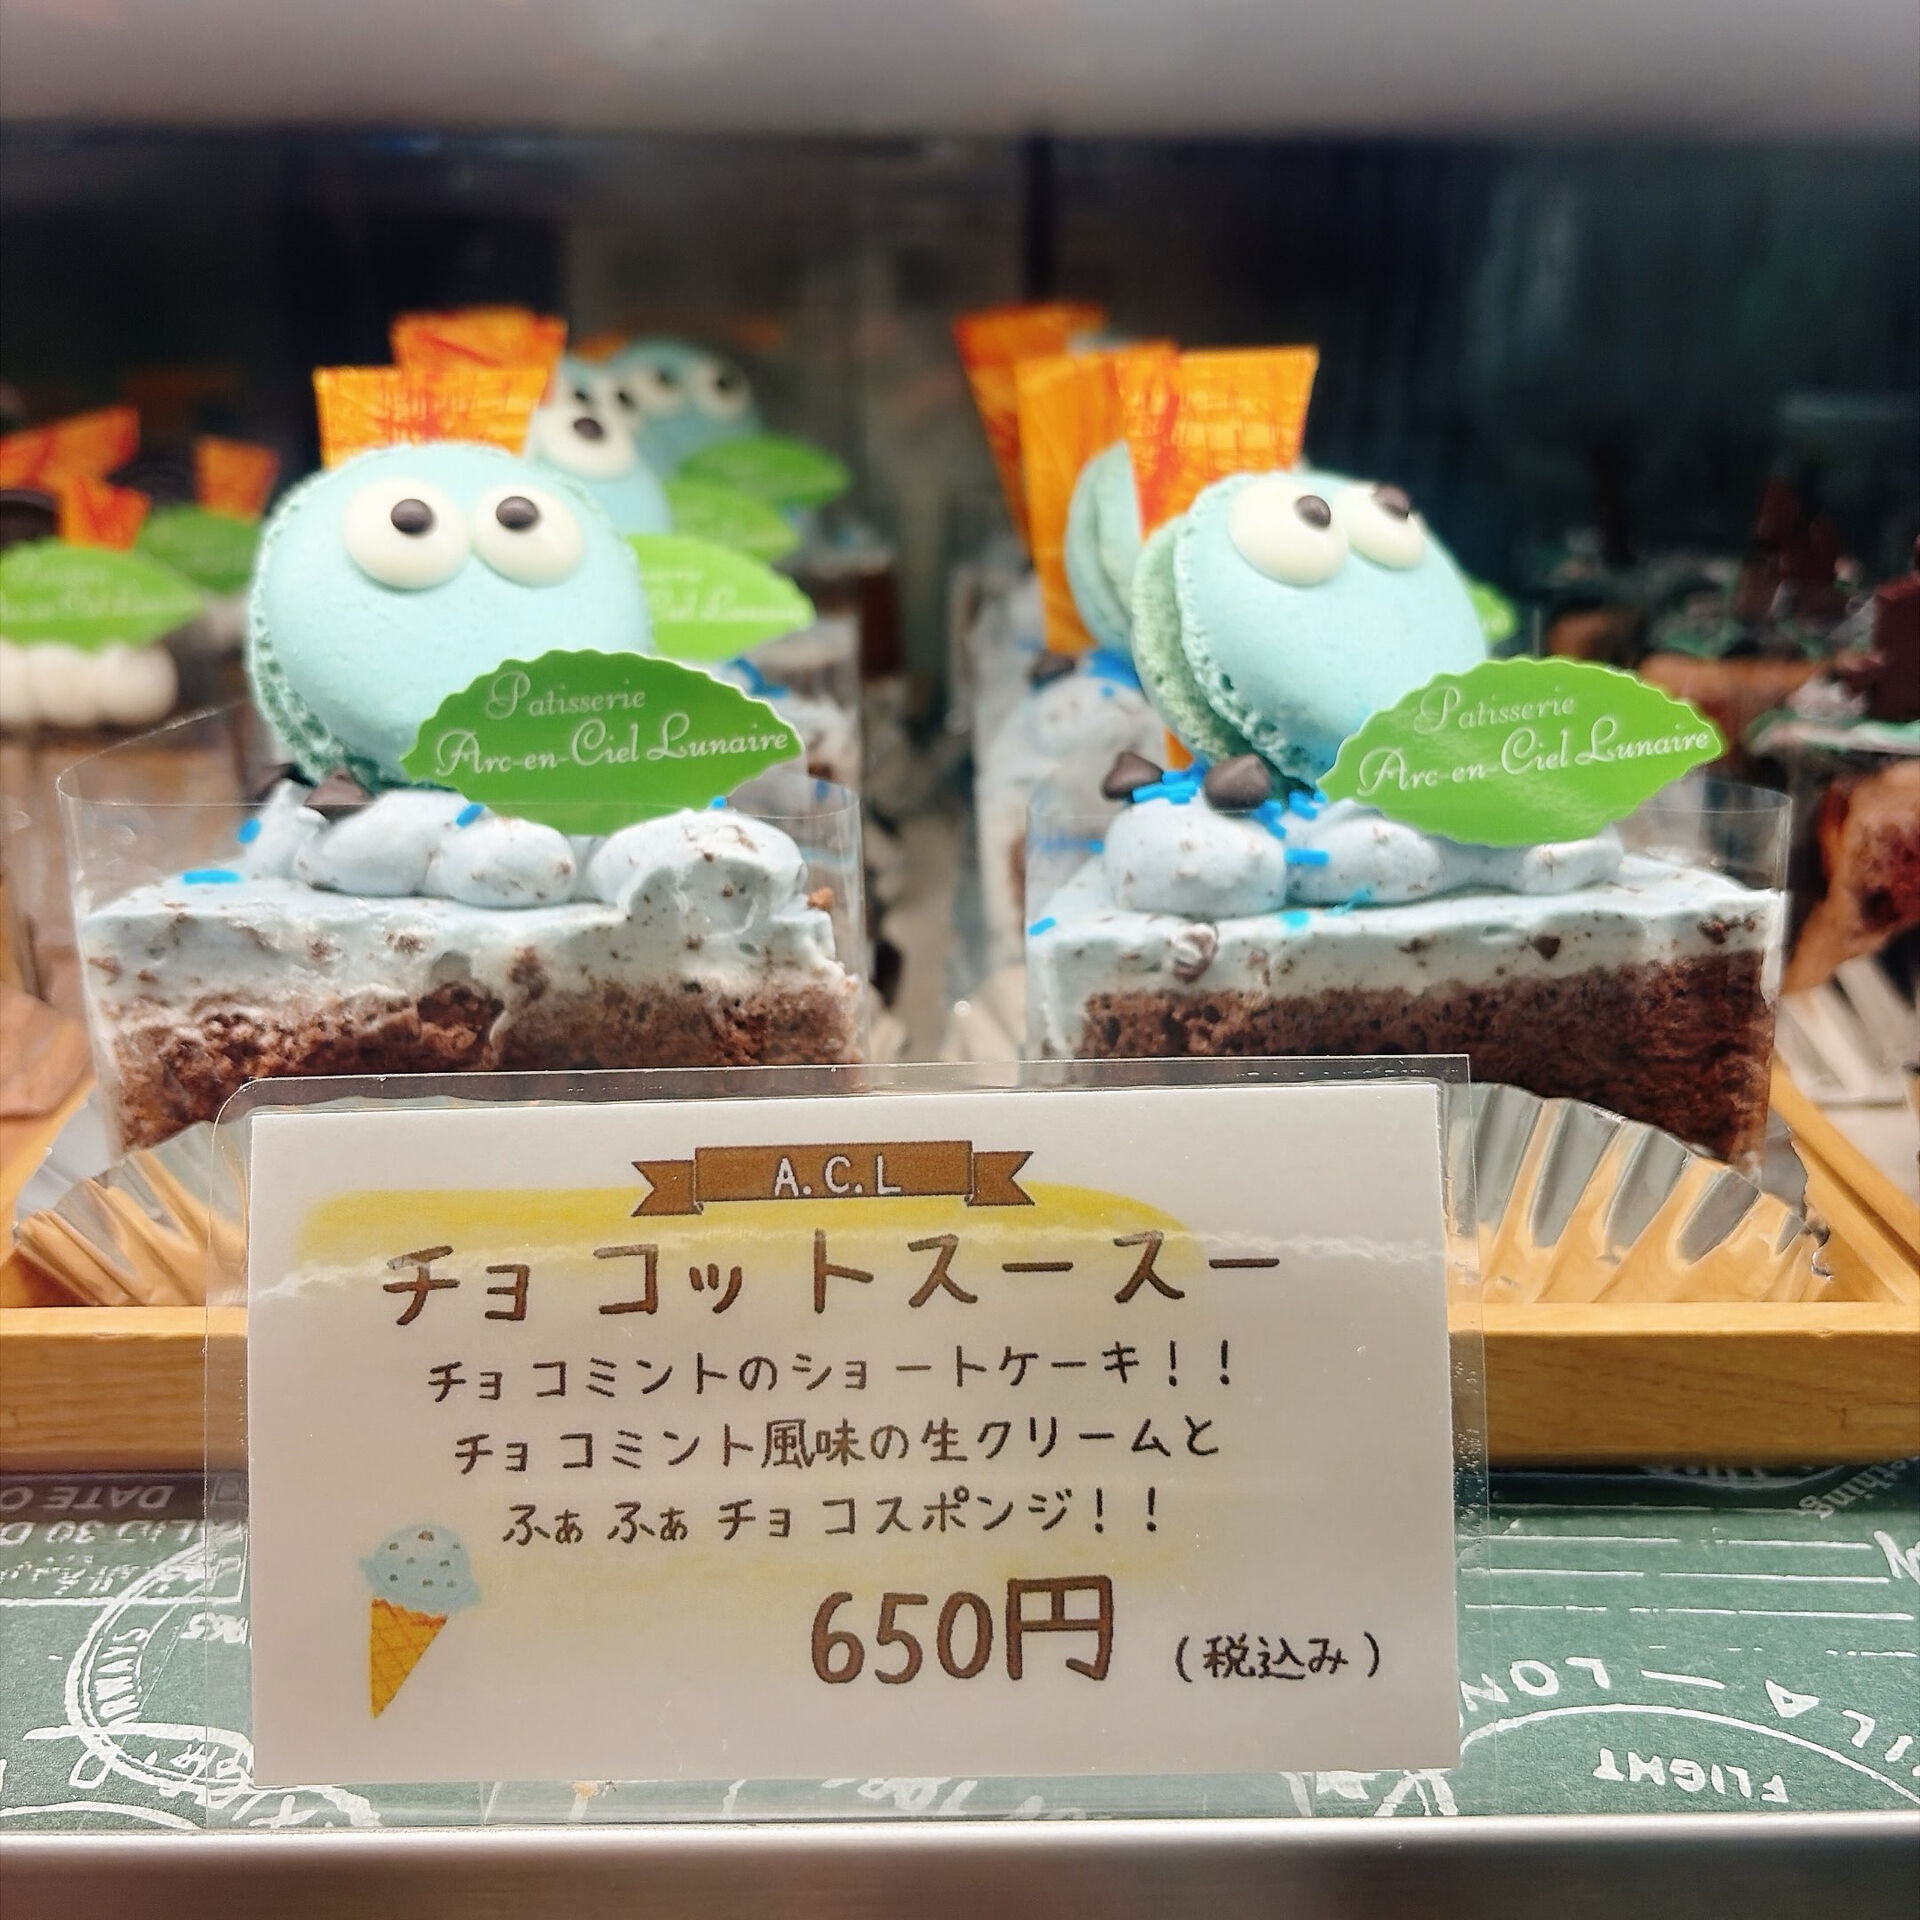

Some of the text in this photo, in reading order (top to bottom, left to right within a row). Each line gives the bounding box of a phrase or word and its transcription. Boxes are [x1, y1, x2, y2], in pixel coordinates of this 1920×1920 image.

[484, 670, 646, 720] Patisserie
[1413, 686, 1576, 735] Patisserie
[435, 712, 789, 777] Arc-en-Ciel Lunaire
[1356, 715, 1710, 797] Arc-en-Ciel Lunaire
[774, 1154, 902, 1197] A.C.L
[382, 1228, 1281, 1325] チョコットスースー
[455, 1415, 1219, 1474] チョコミント風味の生クリームと
[43, 1484, 176, 1510] DATE
[811, 1574, 1114, 1684] 650円
[1592, 1747, 1789, 1803] FLIGHT
